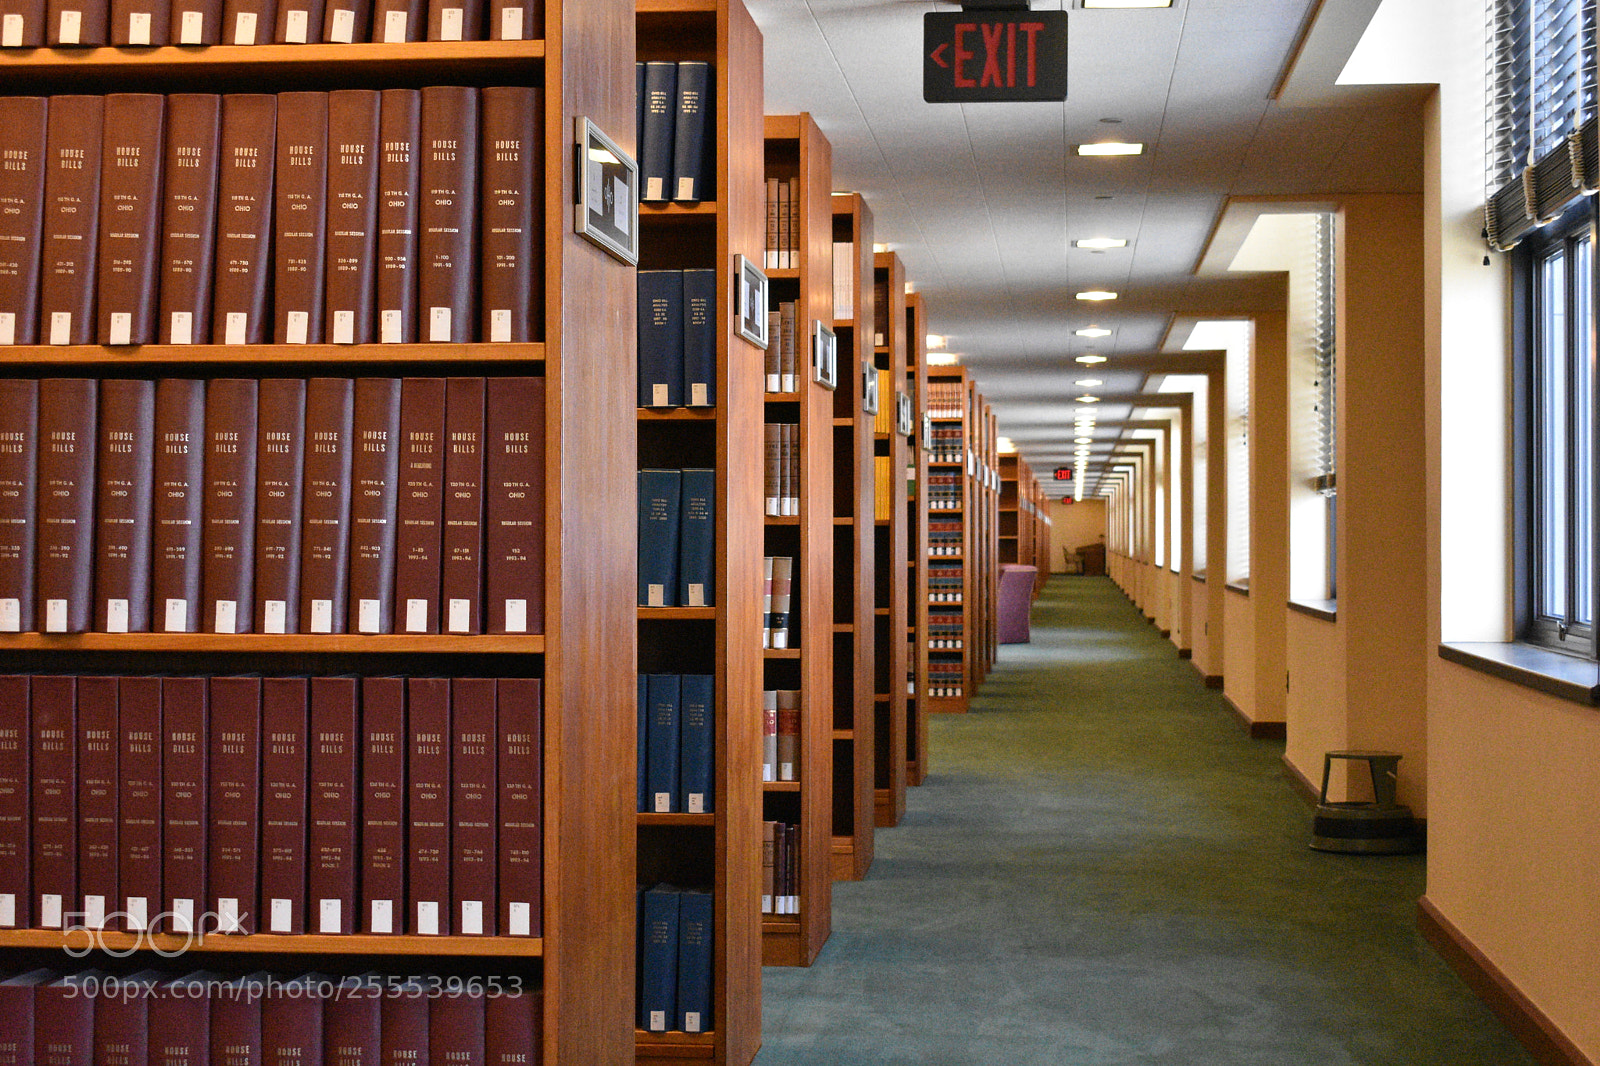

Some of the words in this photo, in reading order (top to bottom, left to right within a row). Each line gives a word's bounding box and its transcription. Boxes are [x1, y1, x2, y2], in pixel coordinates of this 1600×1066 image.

[954, 23, 1044, 88] EXIT
[341, 144, 364, 154] HOUSE
[385, 142, 409, 151] HOUSE
[433, 140, 457, 149] HOUSE
[496, 140, 519, 149] HOUSE
[61, 149, 84, 158] HOUSE
[117, 147, 140, 156] HOUSE
[177, 147, 201, 156] HOUSE
[235, 147, 258, 157] HOUSE
[290, 145, 313, 155] HOUSE
[4, 150, 28, 160] HOUSE
[387, 153, 409, 162] BILLS
[434, 152, 456, 161] BILLS
[496, 152, 518, 161] BILLS
[61, 160, 82, 169] BILLS
[117, 158, 138, 167] BILLS
[178, 158, 199, 167] BILLS
[235, 159, 256, 168] BILLS
[291, 157, 312, 166] BILLS
[341, 156, 363, 165] BILLS
[4, 161, 26, 170] BILLS
[4, 207, 20, 215] OHIO
[0, 432, 23, 441] HOUSE
[52, 432, 75, 441] HOUSE
[109, 432, 133, 441] HOUSE
[165, 433, 189, 442] HOUSE
[215, 432, 238, 441] HOUSE
[267, 432, 290, 441] HOUSE
[315, 432, 338, 441] HOUSE
[363, 431, 387, 440] HOUSE
[410, 432, 434, 441] HOUSE
[452, 432, 476, 441] HOUSE
[505, 432, 529, 441] HOUSE
[1, 444, 23, 453] BILLS
[52, 444, 74, 452] BILLS
[110, 444, 132, 453] BILLS
[166, 445, 188, 454] BILLS
[216, 444, 237, 453] BILLS
[268, 444, 289, 453] BILLS
[315, 444, 336, 453] BILLS
[364, 443, 385, 452] BILLS
[411, 444, 433, 453] BILLS
[454, 444, 475, 453] BILLS
[506, 444, 528, 453] BILLS
[1057, 470, 1071, 480] EXIT
[0, 730, 18, 738] OUSE
